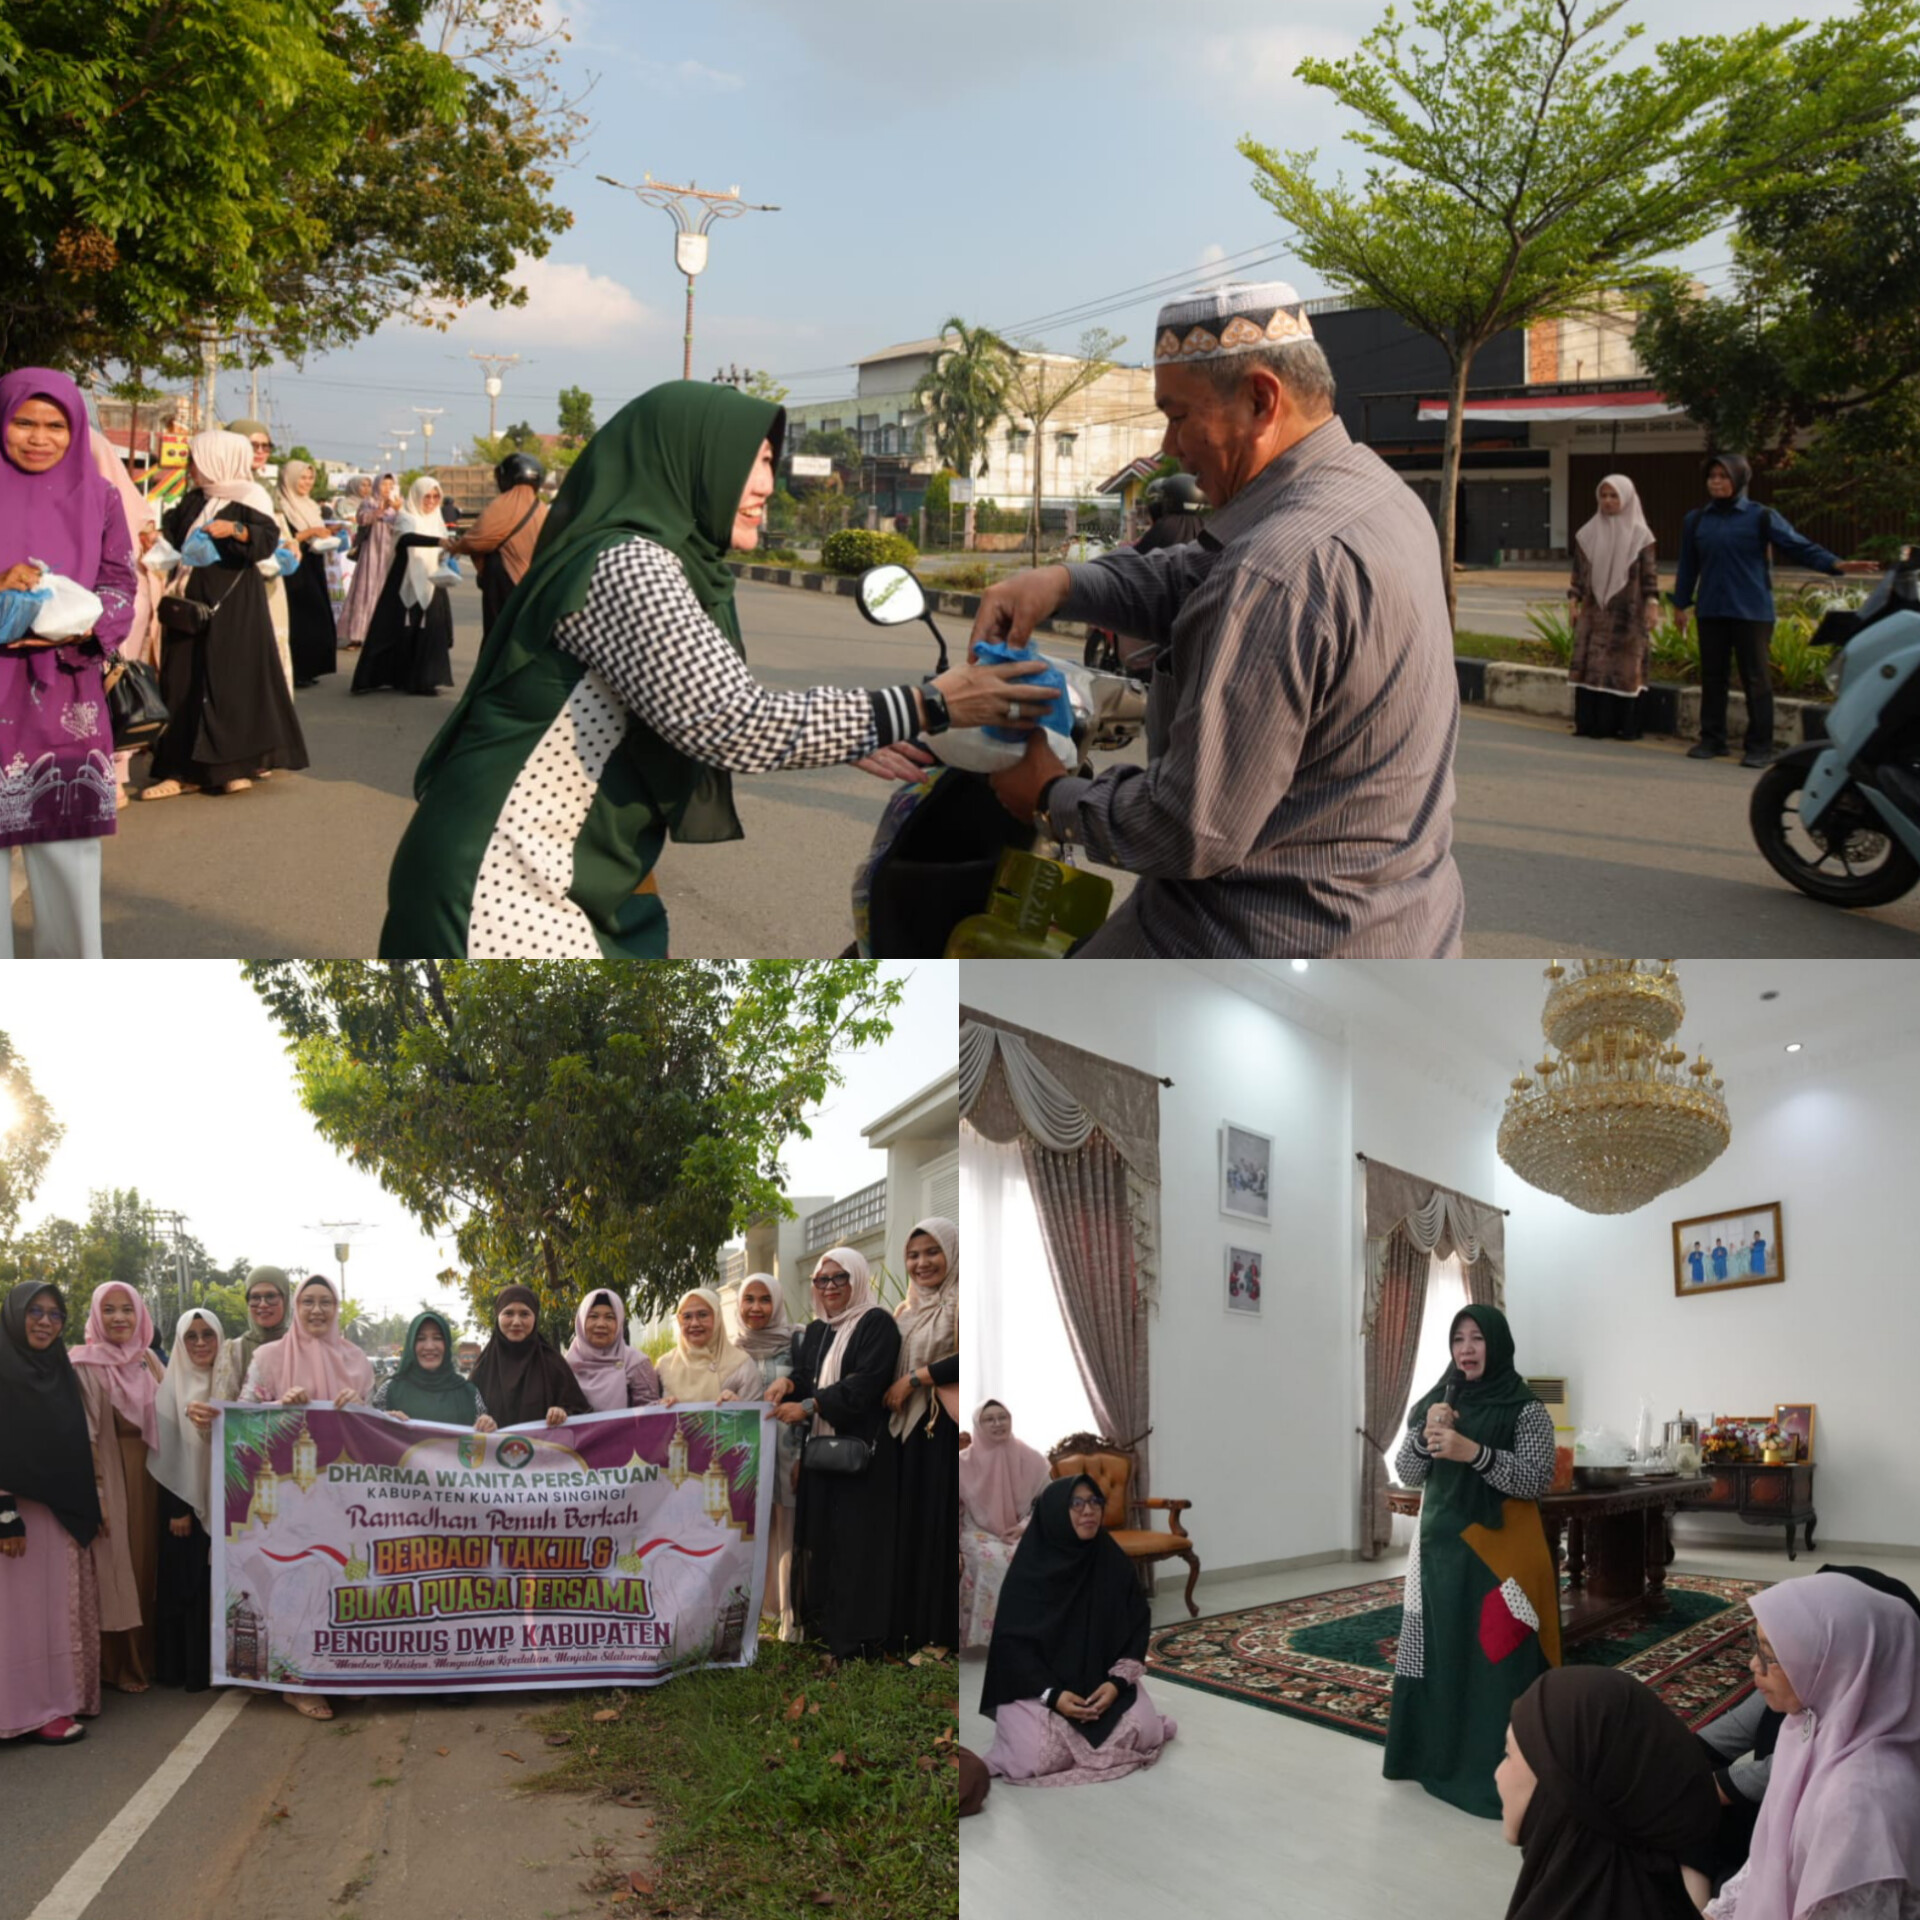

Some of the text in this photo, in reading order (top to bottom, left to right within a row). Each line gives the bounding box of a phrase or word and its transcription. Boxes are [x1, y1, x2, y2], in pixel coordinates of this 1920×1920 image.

[328, 1465, 659, 1489] DHARMA WANITA PERSATUAN
[367, 1487, 626, 1504] KABUPATEN KUANTAN SINGINGI
[345, 1503, 639, 1531] Ramadhan Penuh Berkah
[373, 1535, 492, 1576] BERBAGI
[495, 1536, 589, 1570] TAKJIL
[334, 1576, 650, 1623] BUKA PUASA BERSAMA
[313, 1622, 671, 1655] PENGURUS DWP KABUPATEN
